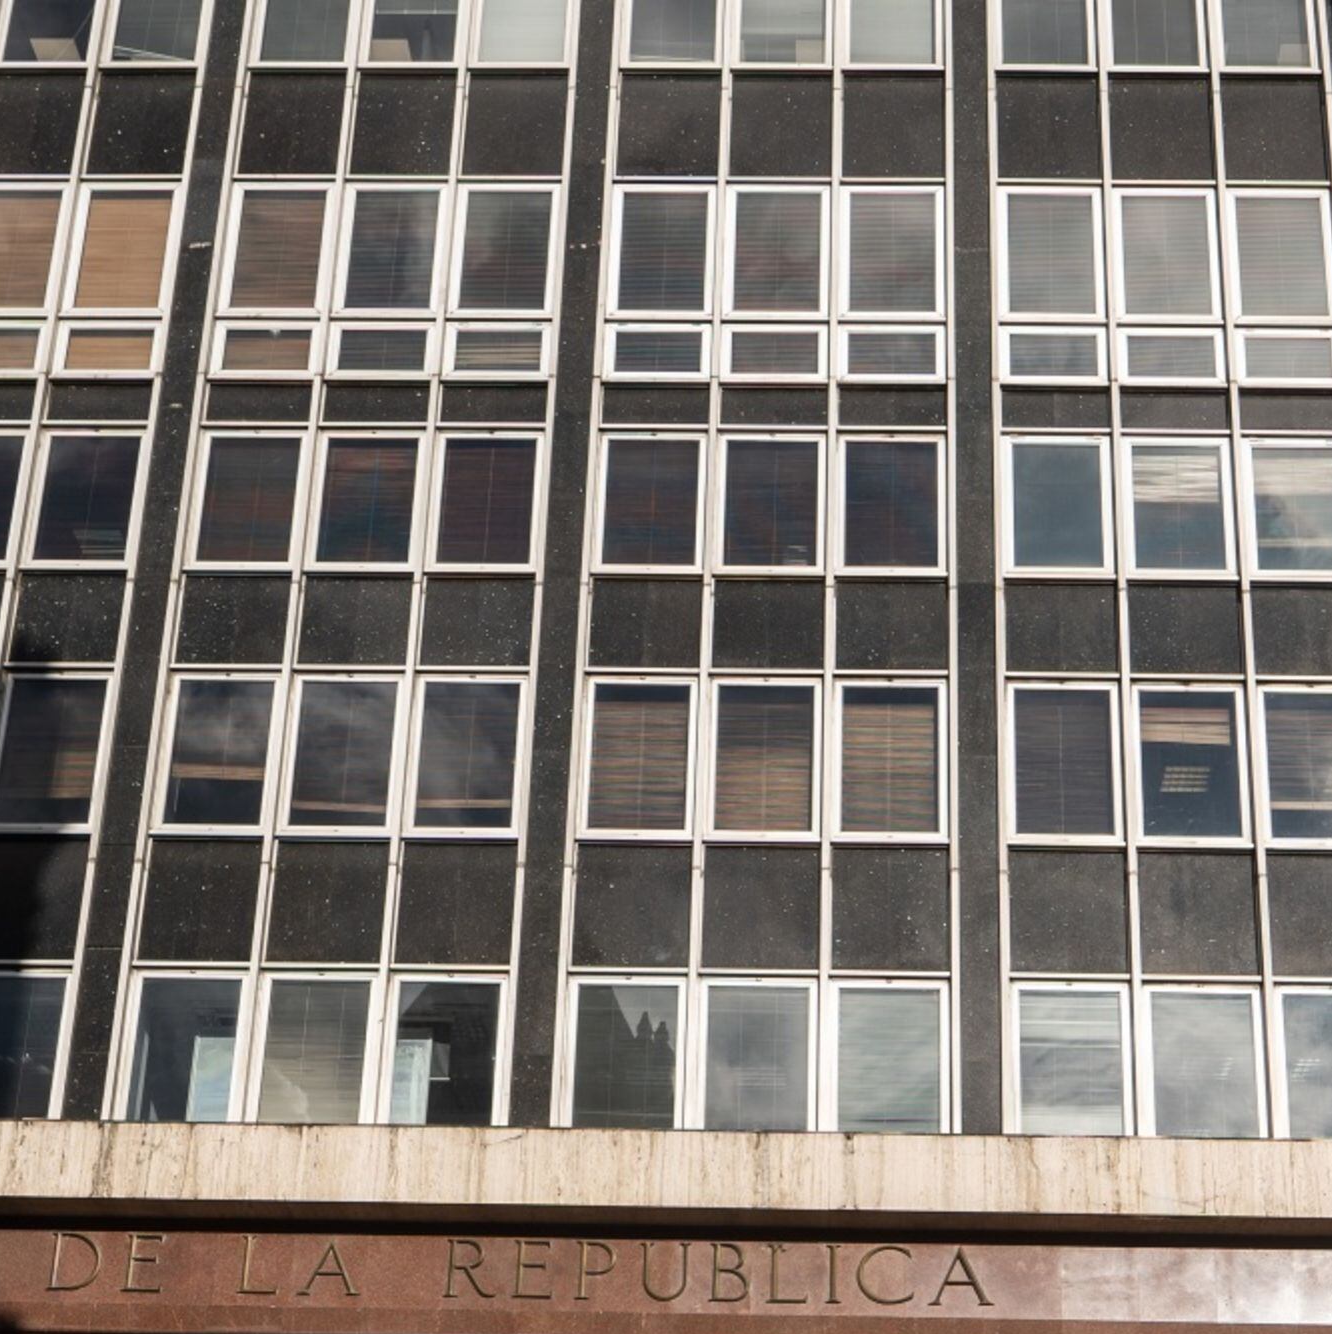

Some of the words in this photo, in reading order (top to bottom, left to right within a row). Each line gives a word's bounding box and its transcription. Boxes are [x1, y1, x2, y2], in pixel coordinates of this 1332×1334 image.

[45, 1231, 167, 1293] DE
[236, 1233, 361, 1297] LA
[441, 1237, 996, 1308] REPUBLICA
